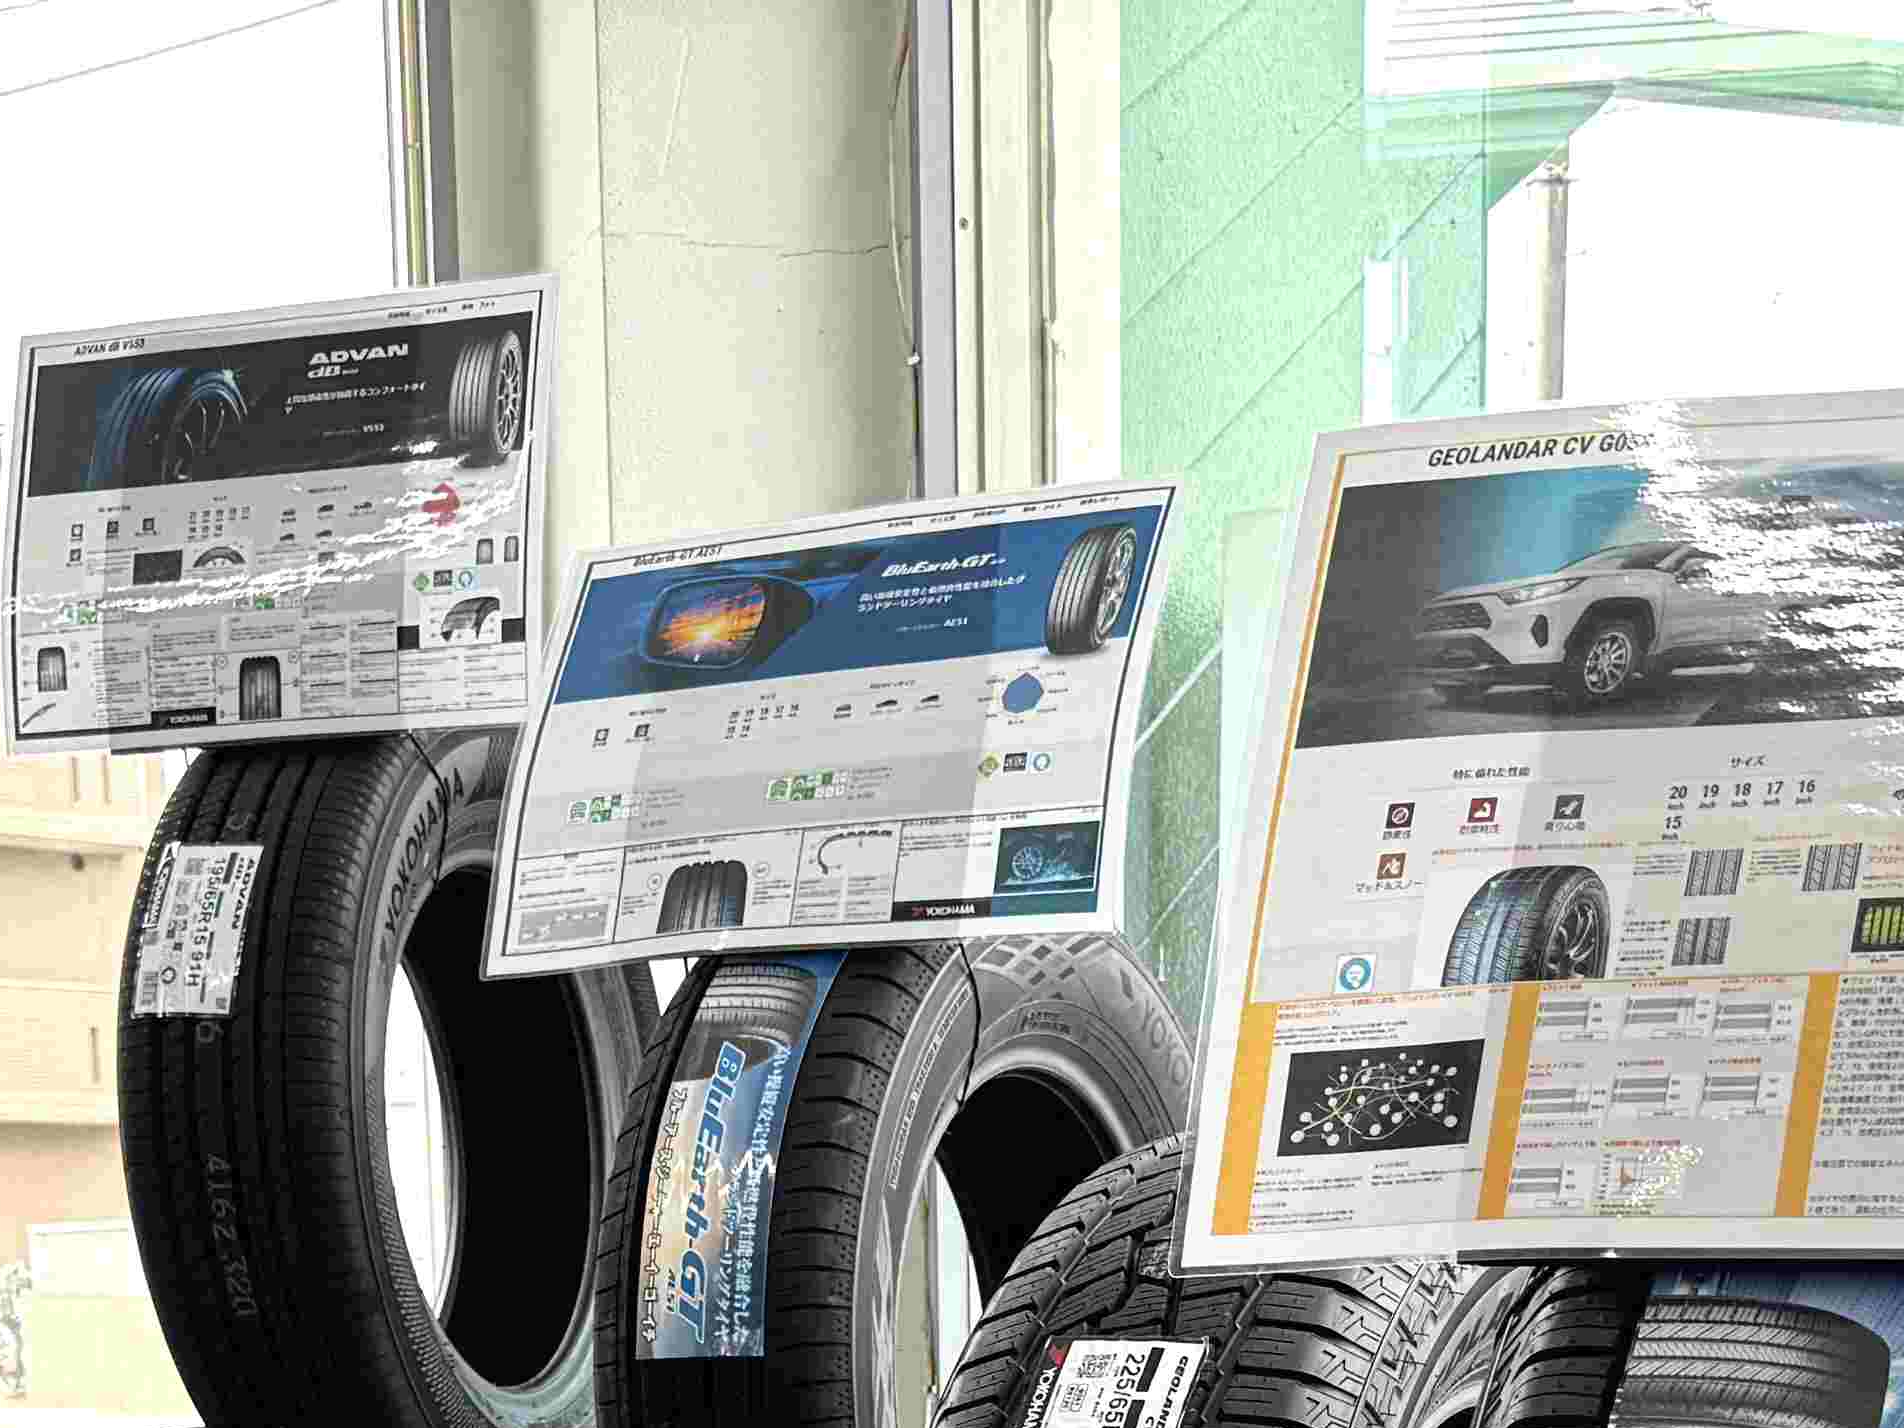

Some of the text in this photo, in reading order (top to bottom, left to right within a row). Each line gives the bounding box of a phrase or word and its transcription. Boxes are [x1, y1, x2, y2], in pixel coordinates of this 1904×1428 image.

[307, 343, 409, 366] ADVAN
[307, 364, 341, 380] dB
[1427, 437, 1558, 468] GEOLANDAR
[1563, 434, 1596, 457] CV
[1668, 778, 1816, 799] 20 19 18 17 16
[1664, 815, 1682, 830] 15
